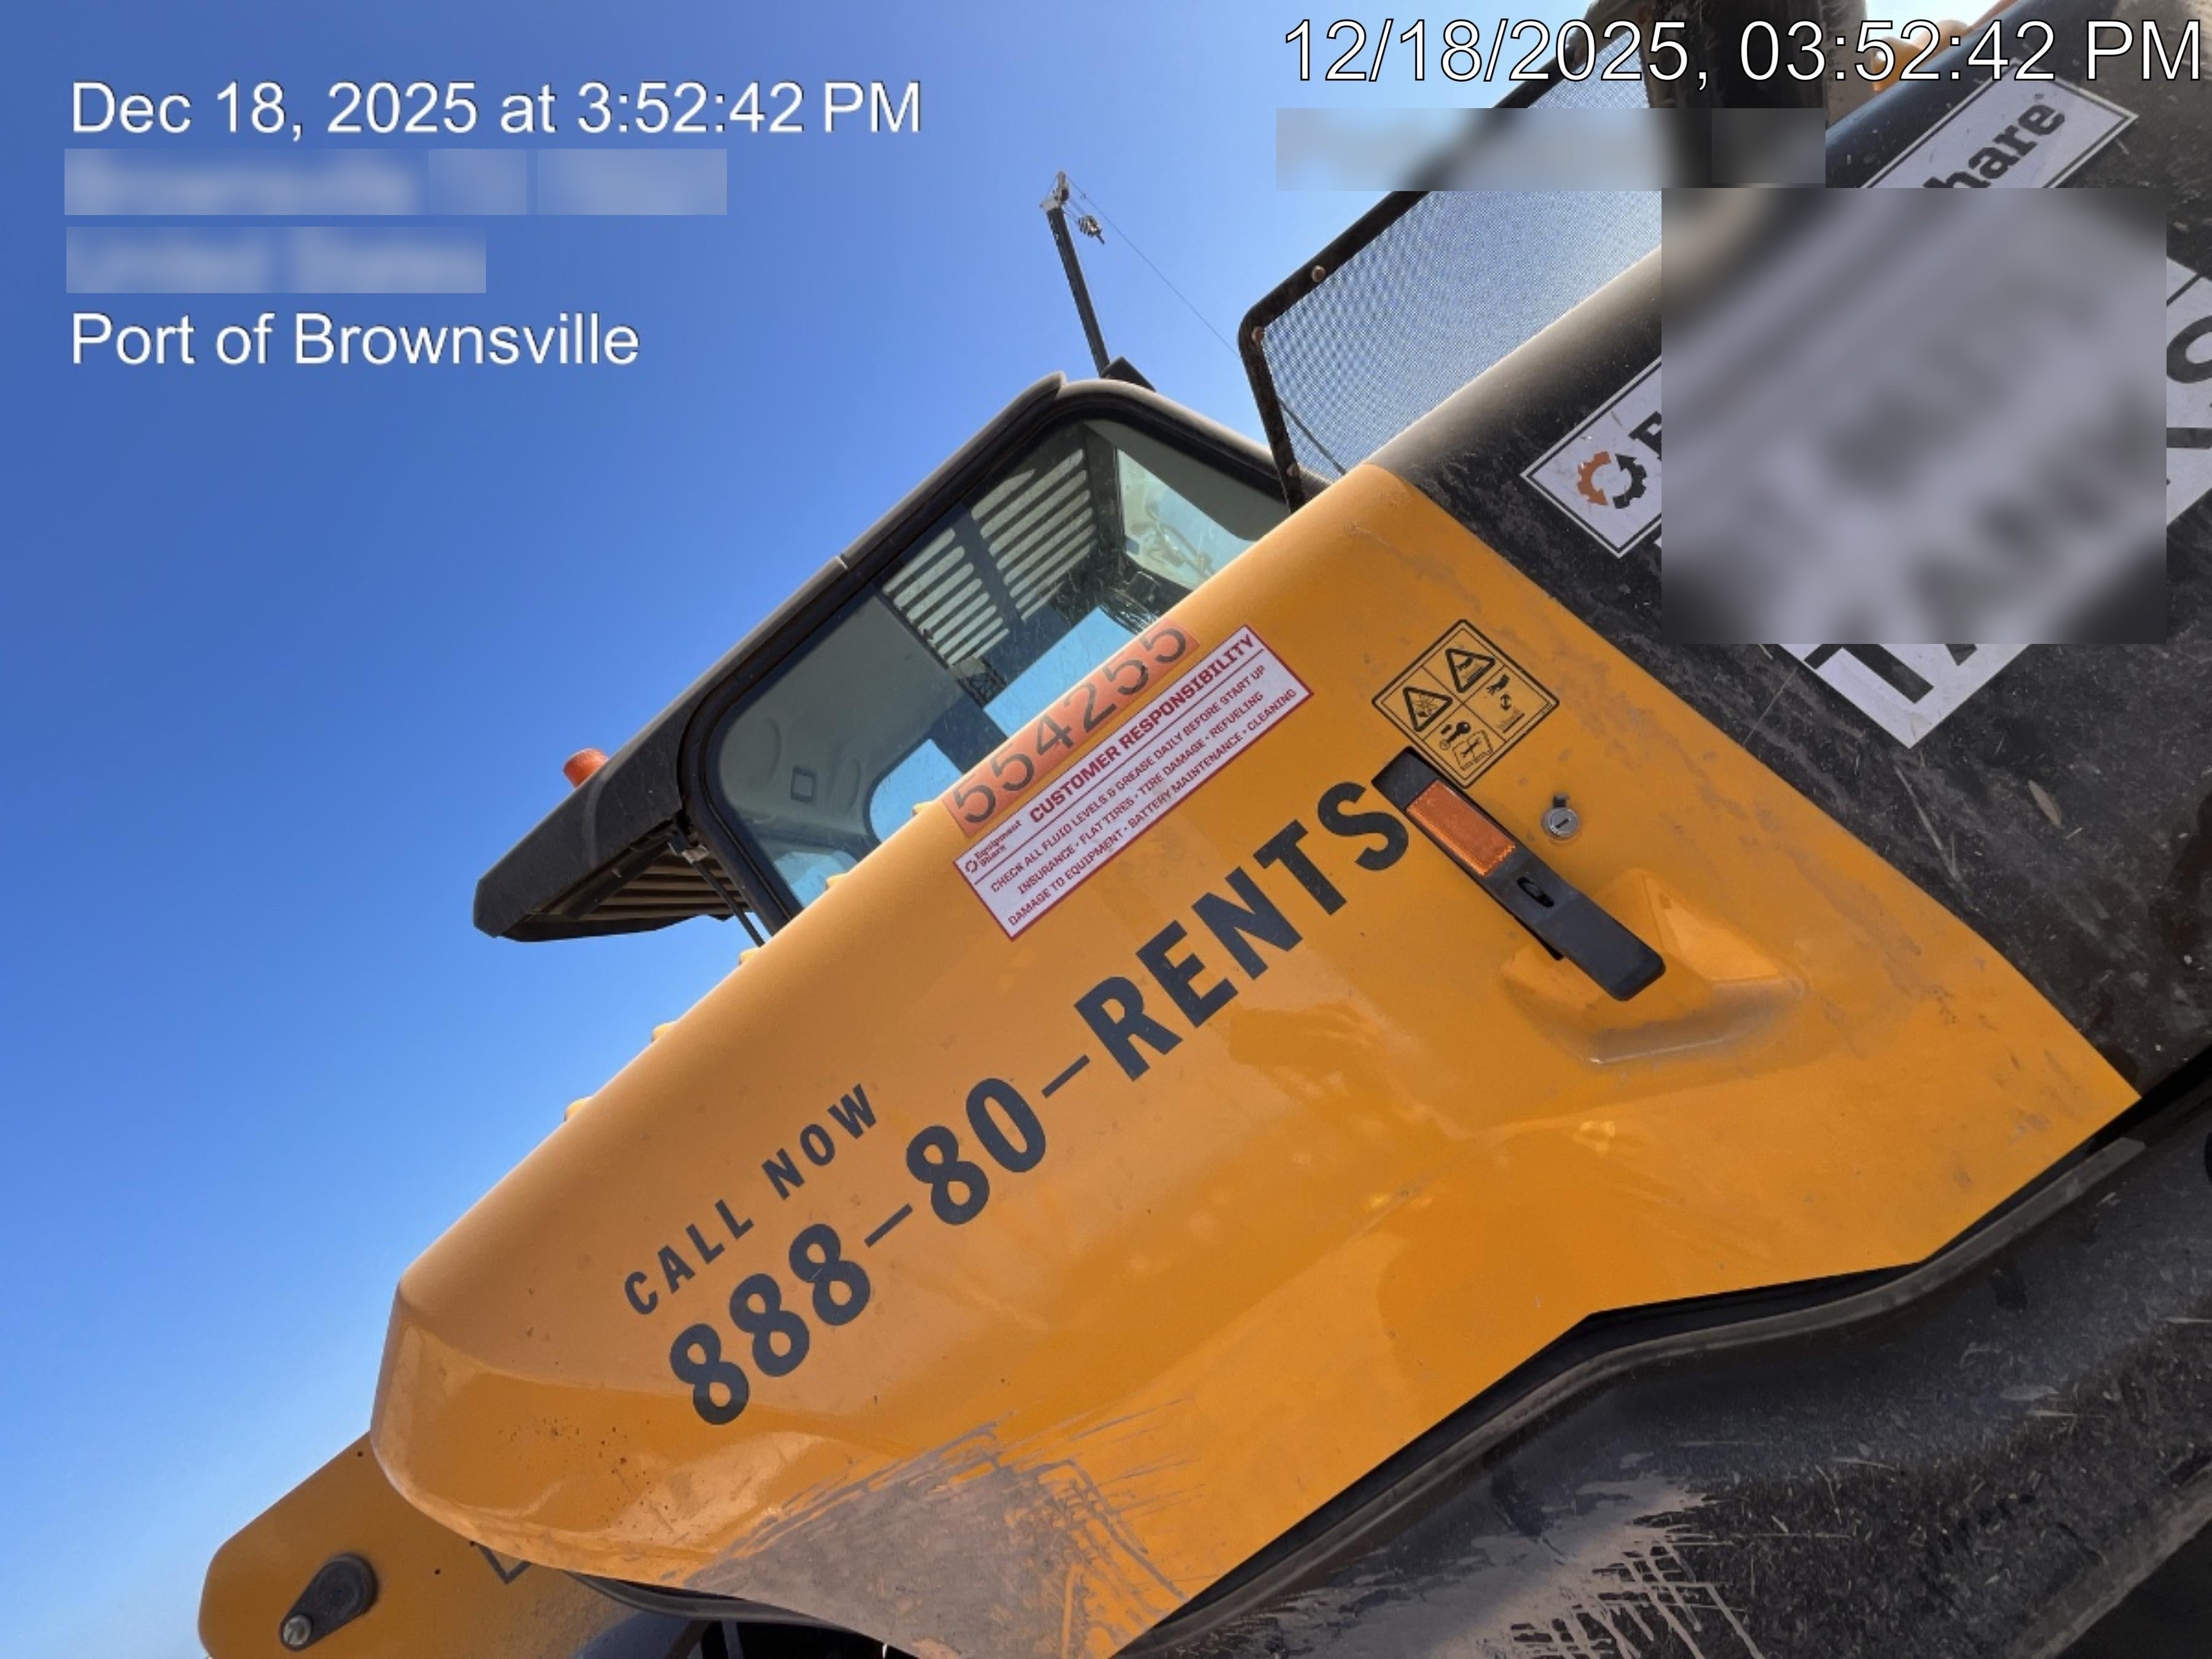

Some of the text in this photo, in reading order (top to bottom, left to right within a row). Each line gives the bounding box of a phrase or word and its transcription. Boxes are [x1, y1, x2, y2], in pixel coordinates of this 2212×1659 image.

[954, 627, 1187, 825] 554255
[989, 862, 1024, 893] CHECK
[1022, 847, 1042, 866] ALL
[1041, 823, 1072, 851] FLUID
[1070, 794, 1108, 826] LEVELS
[1115, 756, 1155, 790] GREASE
[1153, 732, 1184, 759] DAILY
[1182, 702, 1221, 735] BEFORE
[1218, 676, 1253, 705] START
[1250, 664, 1267, 680] UP
[1008, 688, 1296, 927] DAMAGE TO EQUIPMENT BATTERY MAINTENANCE CLEANING
[1017, 691, 1264, 895] INSURANCE FLAT TIRES TIRE DAMAGE REFUELING
[1028, 634, 1257, 823] CUSTOMER RESPONSIBILITY
[624, 1084, 877, 1315] CALL NOW
